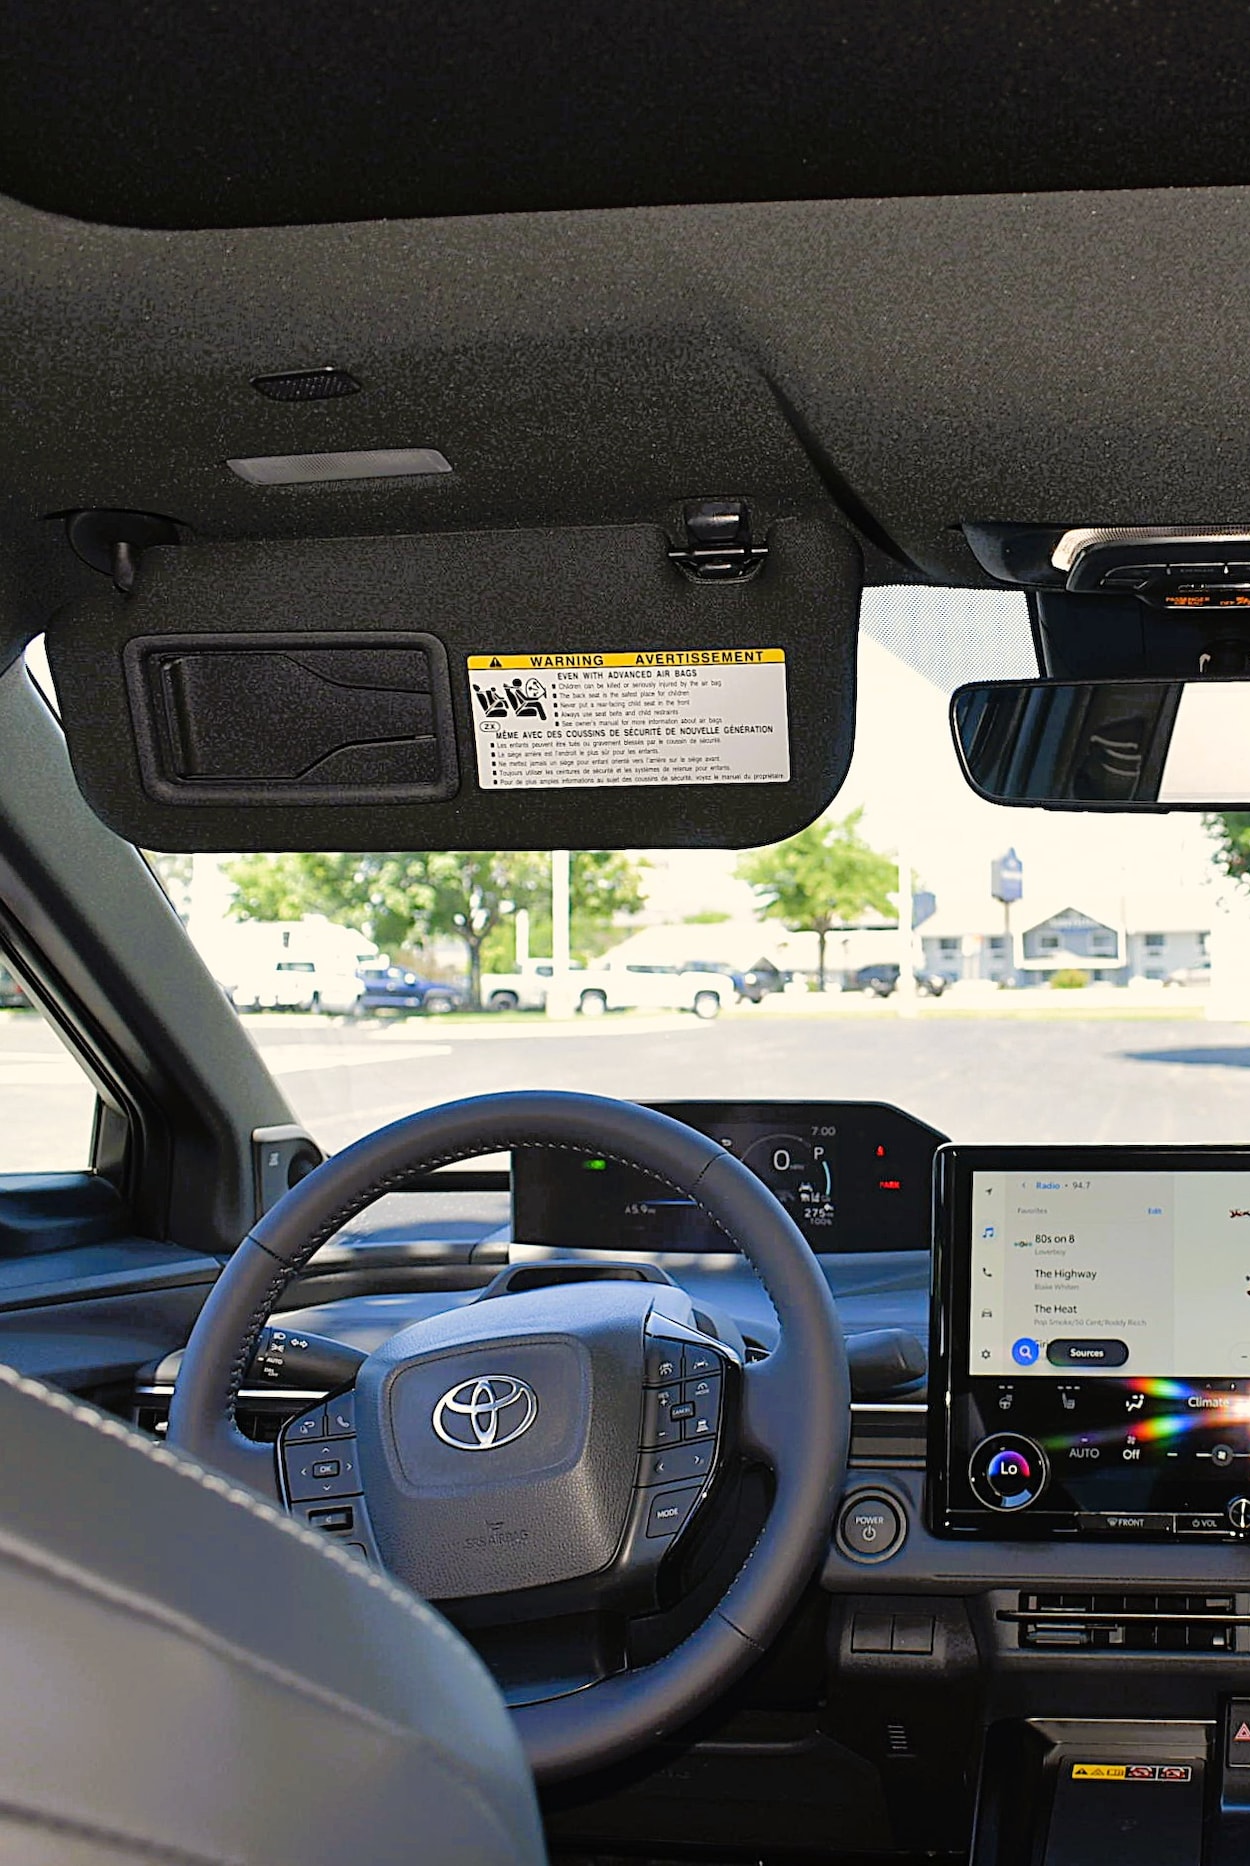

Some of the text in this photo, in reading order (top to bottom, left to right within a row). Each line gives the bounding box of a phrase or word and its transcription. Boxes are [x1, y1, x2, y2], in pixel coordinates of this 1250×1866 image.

[530, 651, 763, 666] WARNING AVERTISSEMENT
[557, 669, 697, 681] EVEN WITH ADVANCED AIR BAGS
[523, 730, 542, 739] AVEC
[546, 730, 562, 739] DES
[566, 729, 606, 738] COUSSINS
[609, 729, 620, 737] DE
[665, 727, 676, 736] DE
[680, 726, 720, 735] NOUVELLE
[814, 1147, 824, 1160] P
[804, 1208, 825, 1218] 275
[1035, 1234, 1052, 1244] 80s
[1069, 1234, 1075, 1244] 8
[1034, 1269, 1097, 1280] The Highway
[1034, 1304, 1077, 1313] The Heat
[1070, 1348, 1104, 1357] Sources
[1188, 1397, 1230, 1408] Climate
[1069, 1448, 1100, 1459] AUTO
[1123, 1449, 1141, 1460] Off
[1001, 1462, 1018, 1475] Lo
[657, 1508, 678, 1519] MODE
[855, 1516, 884, 1525] POWER
[1118, 1519, 1145, 1527] FRONT
[1201, 1519, 1217, 1528] VOL
